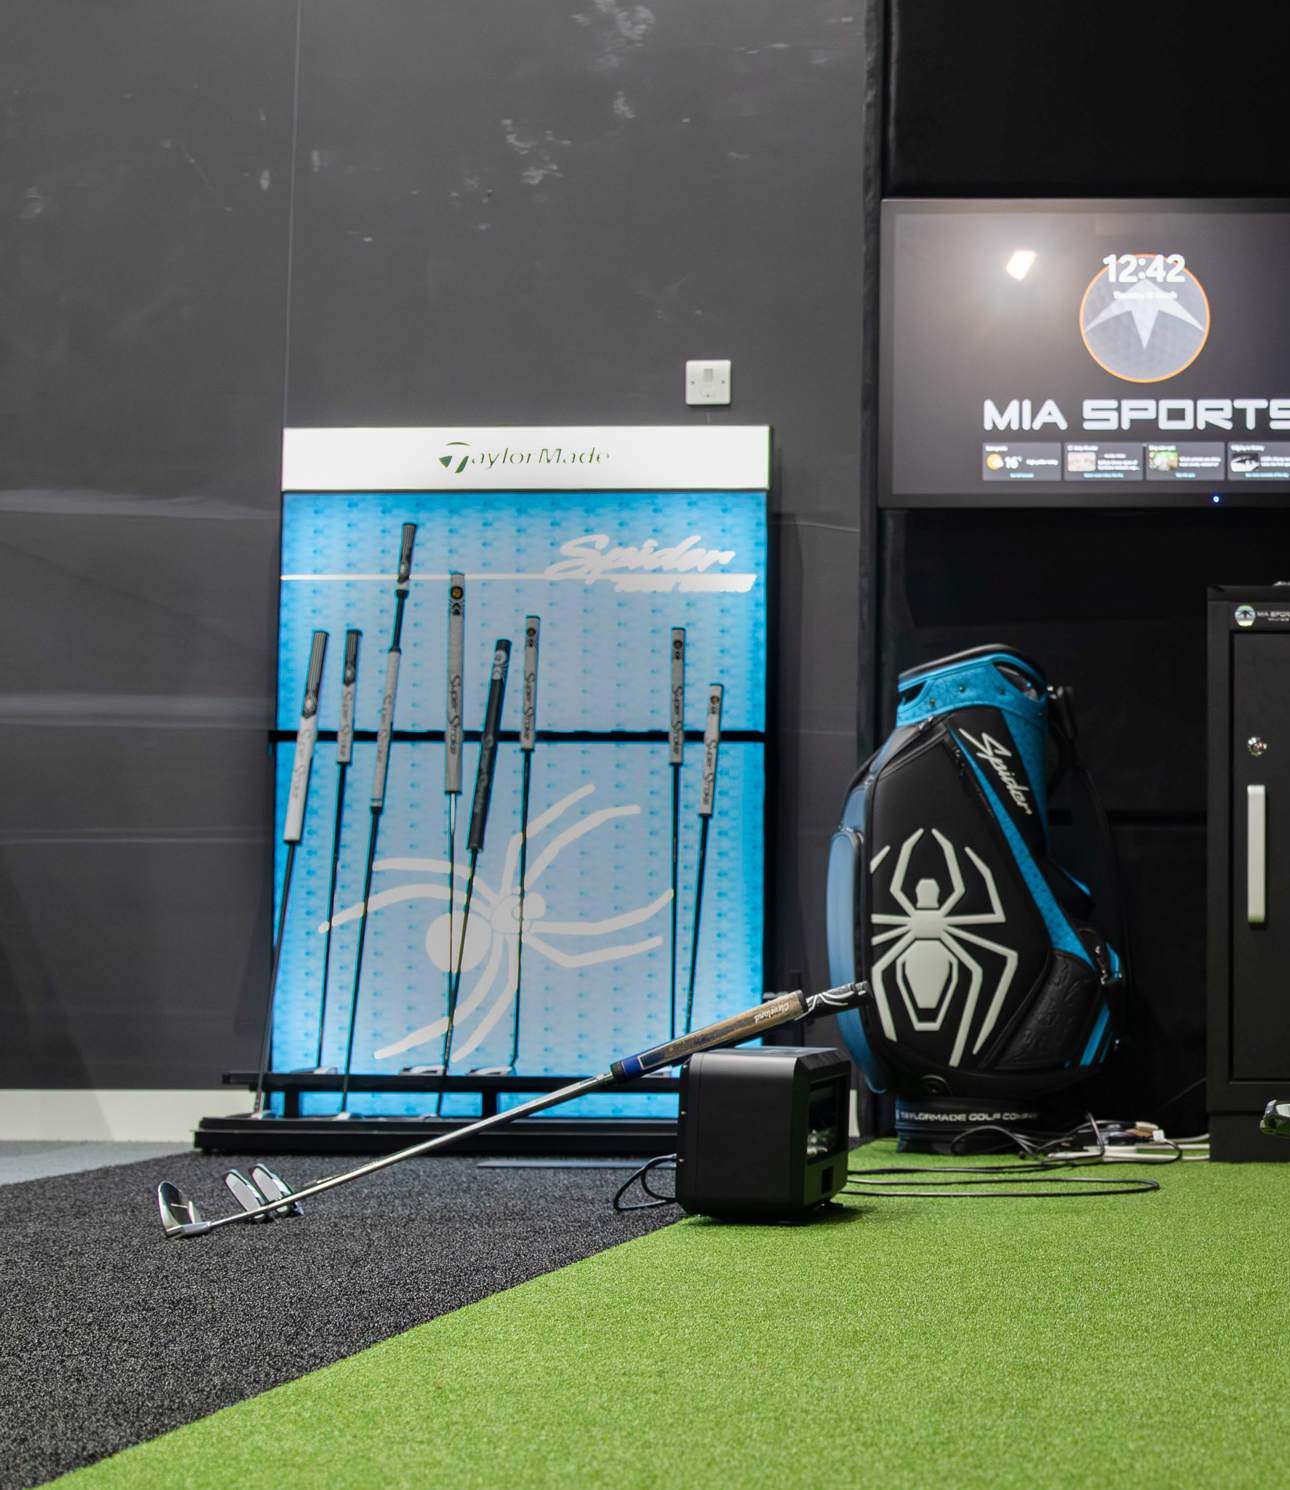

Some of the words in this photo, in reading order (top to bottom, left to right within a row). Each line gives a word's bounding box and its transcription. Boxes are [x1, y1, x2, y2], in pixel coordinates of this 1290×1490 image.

[1103, 253, 1186, 283] 12:42
[983, 399, 1068, 431] MIA
[438, 442, 610, 474] TaylorMade
[543, 534, 736, 585] Spider
[959, 728, 1032, 815] Spider
[753, 1002, 790, 1025] Cleveland
[968, 1112, 1001, 1121] GOLF
